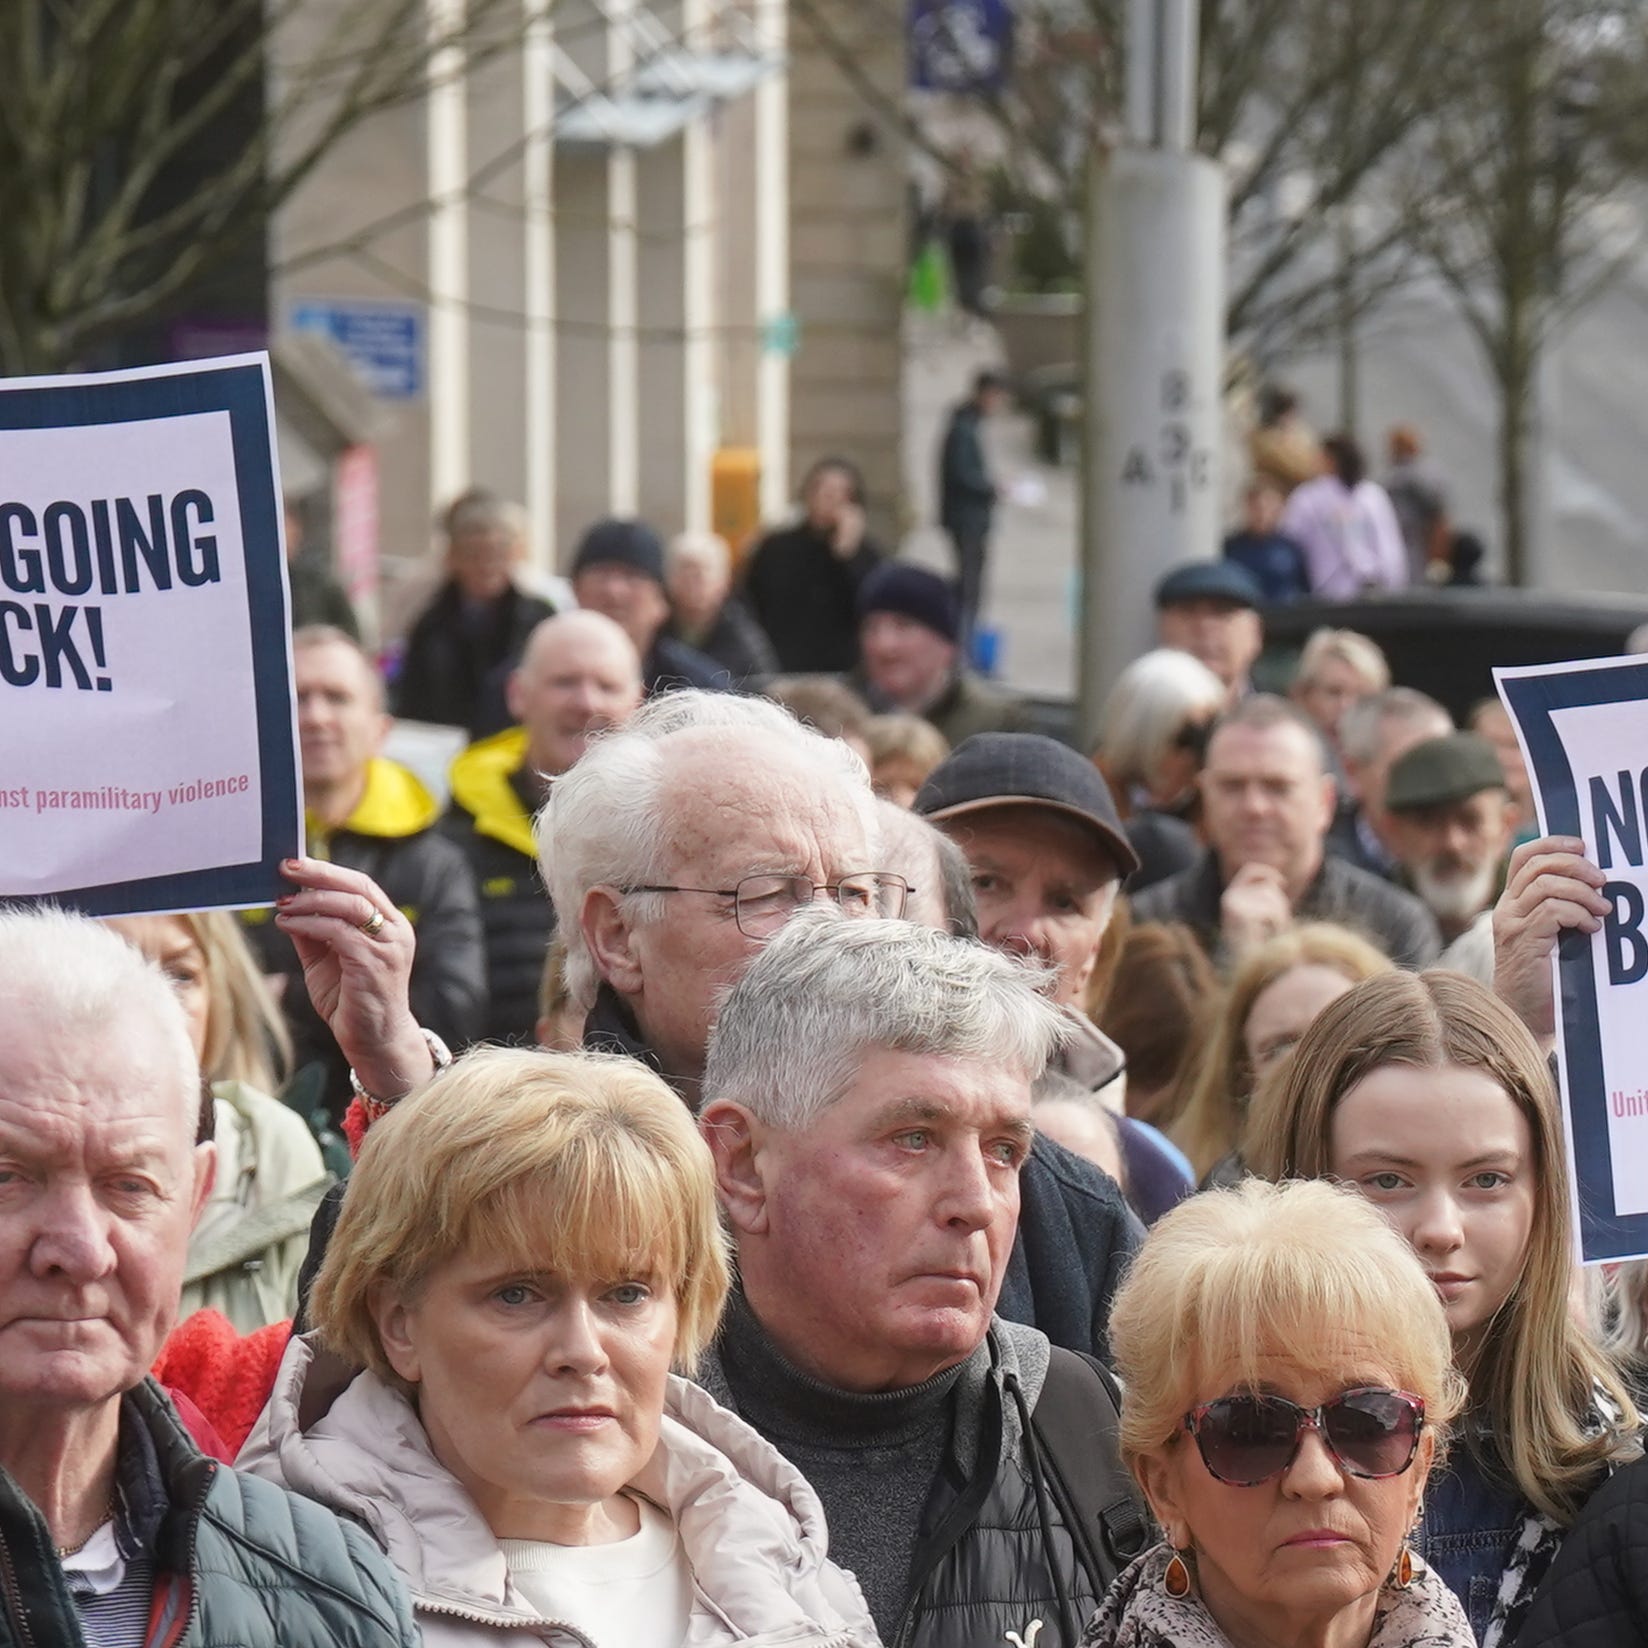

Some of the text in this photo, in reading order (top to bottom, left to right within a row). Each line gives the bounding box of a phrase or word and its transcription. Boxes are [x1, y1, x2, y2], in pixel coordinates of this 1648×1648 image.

[0, 489, 220, 596] GOING
[36, 787, 162, 813] paramilitary
[169, 776, 248, 804] violence
